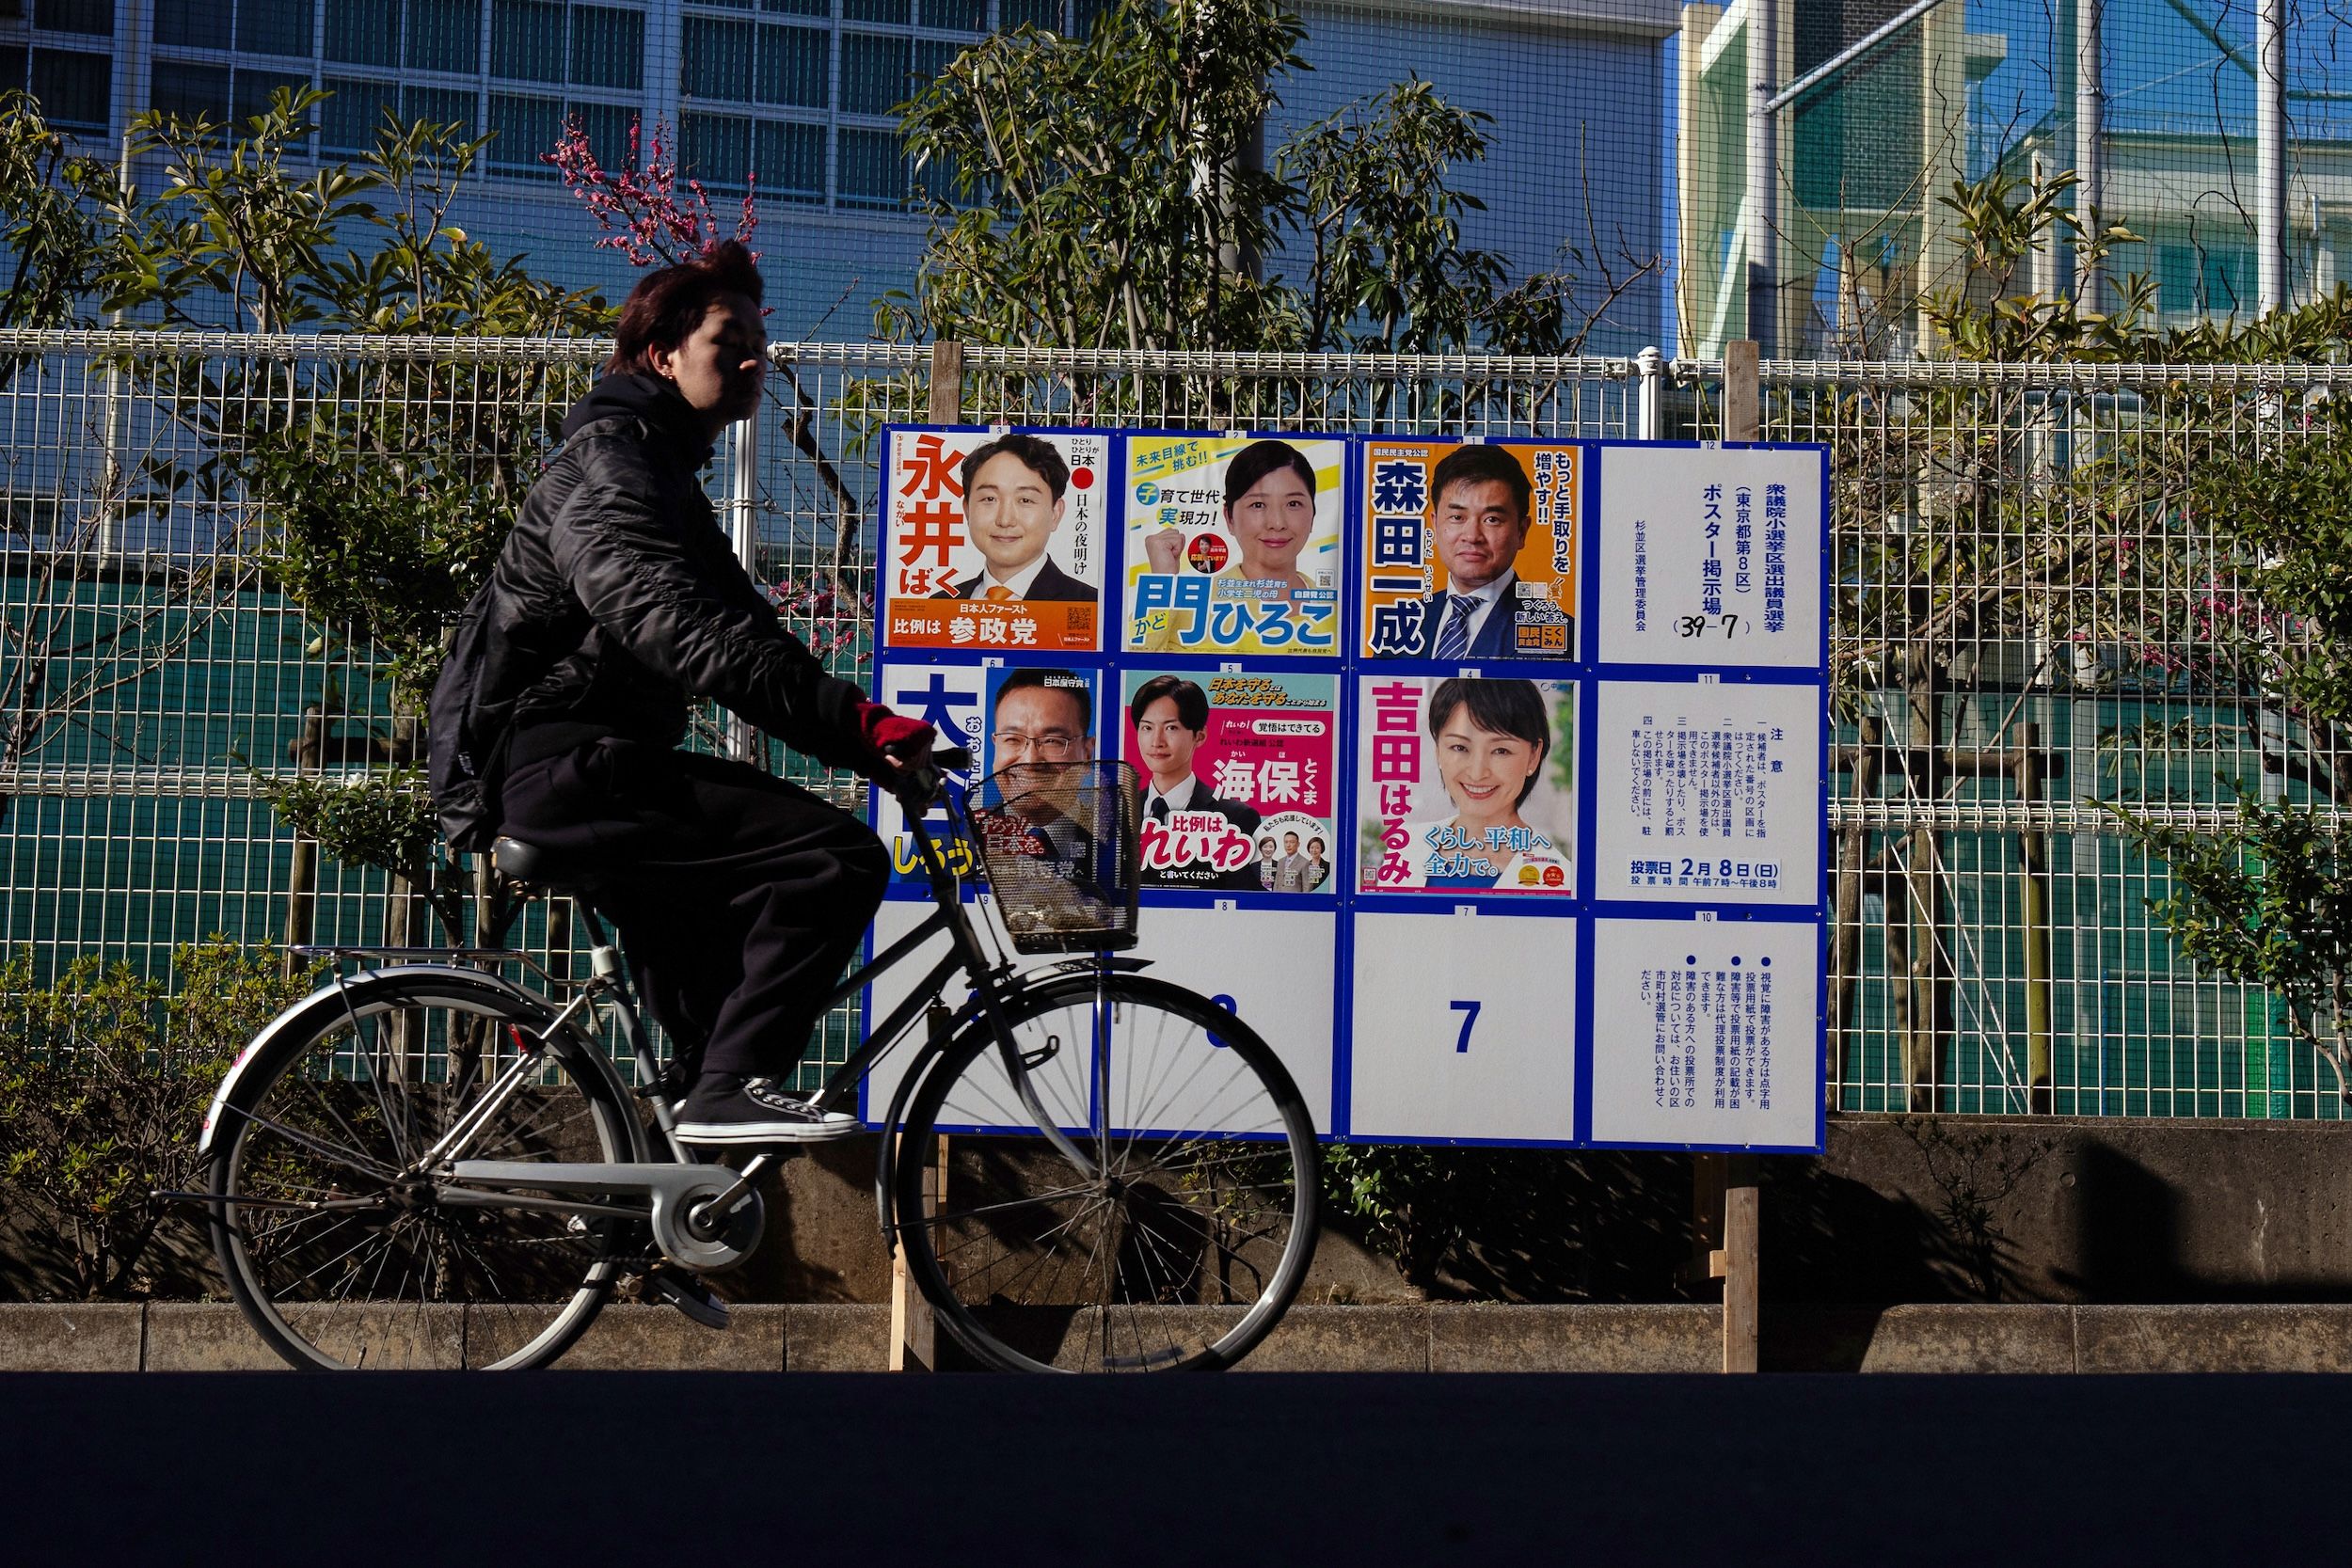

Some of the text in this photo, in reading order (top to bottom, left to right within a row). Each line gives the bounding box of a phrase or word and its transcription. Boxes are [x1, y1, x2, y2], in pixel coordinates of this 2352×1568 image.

[996, 426, 1003, 435] 3
[1374, 448, 1428, 456] 国民民主党公認
[1072, 455, 1095, 467] 日本
[1136, 441, 1199, 467] 未来目線で
[896, 500, 906, 527] ながい
[1073, 494, 1088, 575] 日本の夜明け
[1159, 508, 1216, 526] 実現力!
[1553, 452, 1571, 574] もっと手取りを
[1371, 461, 1426, 654] 森田一成
[1703, 483, 1722, 614] ポスター掲示場
[1736, 486, 1751, 593] (東京都第8区)
[1765, 483, 1787, 632] 衆議院小選挙区選出議員選挙
[1217, 578, 1287, 588] 杉並生まれ杉並育ち
[1217, 590, 1278, 599] 小学生二児の母
[1635, 520, 1645, 631] 杉並区選挙管理委員会
[894, 617, 1038, 645] 比例は 参政党
[960, 604, 1027, 614] 日本人ファースト
[1135, 613, 1166, 635] かど
[1516, 611, 1568, 624] 新しい答え。
[1209, 677, 1281, 691] 日本を守るとは
[1213, 692, 1327, 706] あなたを守ることから始まる
[1259, 723, 1320, 734] 覚悟はできてる
[1771, 728, 1783, 772] 注意
[1631, 730, 1640, 816] 車しないでください。
[1655, 731, 1663, 780] せられます。
[1689, 731, 1697, 790] 用できません。
[1734, 732, 1744, 800] はってください。
[1212, 759, 1300, 803] 海保
[1304, 758, 1317, 804] とくま
[1372, 682, 1422, 884] 吉田はるみ
[1699, 732, 1709, 836] このポスター掲示場を使
[1711, 732, 1721, 832] 選挙候補者以外の方は、
[1745, 732, 1756, 837] 定された番号の区画に
[1140, 821, 1251, 867] れいわ
[1172, 816, 1222, 832] 比例は
[1423, 826, 1550, 850] くらし、平和へ
[1159, 871, 1218, 879] と書いてください
[1423, 853, 1499, 876] 全力で。
[982, 895, 989, 905] 9
[1222, 902, 1228, 911] 8
[1463, 908, 1469, 916] 7
[1702, 913, 1711, 922] 10
[1641, 971, 1651, 1006] ださい。
[1701, 972, 1710, 1017] できます。
[1450, 1001, 1481, 1053] 7
[1655, 971, 1665, 1107] 市町村選管にお問い合わせく
[1670, 971, 1681, 1107] 対応については、お住いの区
[1685, 972, 1696, 1107] 障害のある方への投票所での
[1715, 972, 1725, 1108] 難な方は代理投票制度が利用
[1730, 972, 1740, 1109] 障害等で投票用紙の記載が困
[1745, 972, 1756, 1103] 投票用紙で投票ができます。
[1759, 973, 1771, 1109] 視覚に障害がある方は点字用
